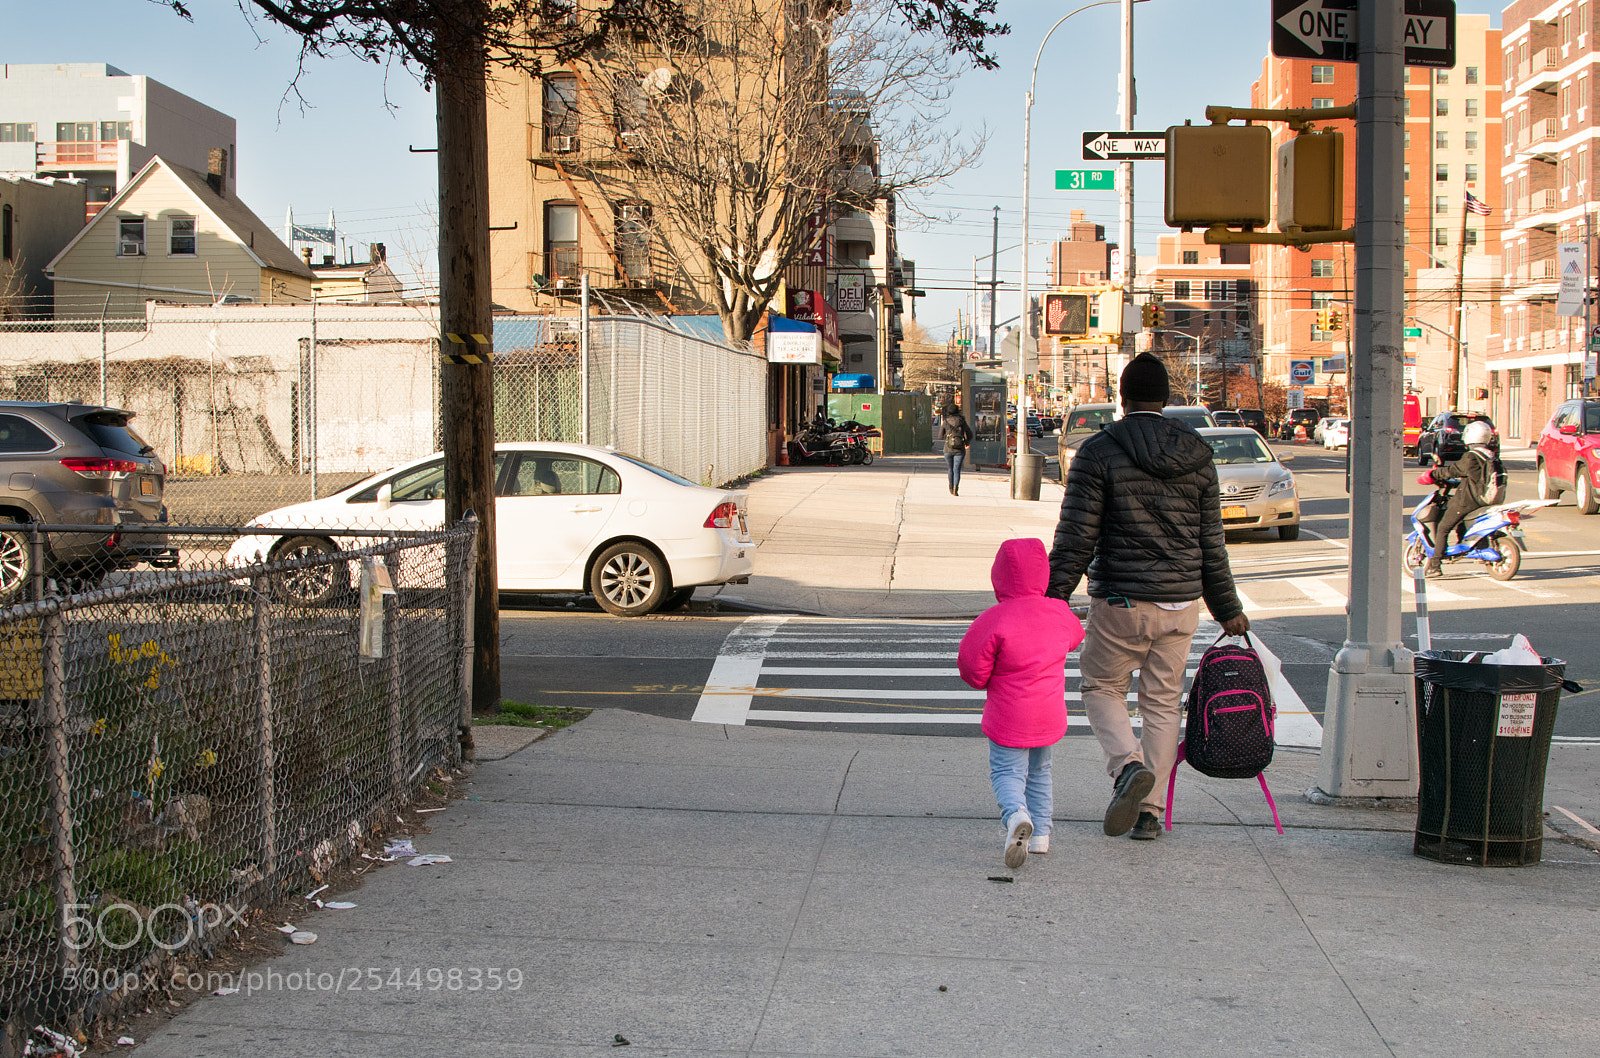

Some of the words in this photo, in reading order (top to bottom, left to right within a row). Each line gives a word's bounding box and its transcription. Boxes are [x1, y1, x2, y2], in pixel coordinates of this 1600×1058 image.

[1299, 10, 1348, 38] ONE
[1404, 18, 1434, 44] AY
[1094, 140, 1118, 152] ONE
[1134, 140, 1160, 152] WAY
[1070, 171, 1085, 189] 31
[1091, 171, 1103, 181] RD
[839, 288, 863, 300] DELI
[838, 300, 864, 310] GROCERY
[1293, 369, 1312, 377] Gulf
[1522, 693, 1535, 701] ONLY
